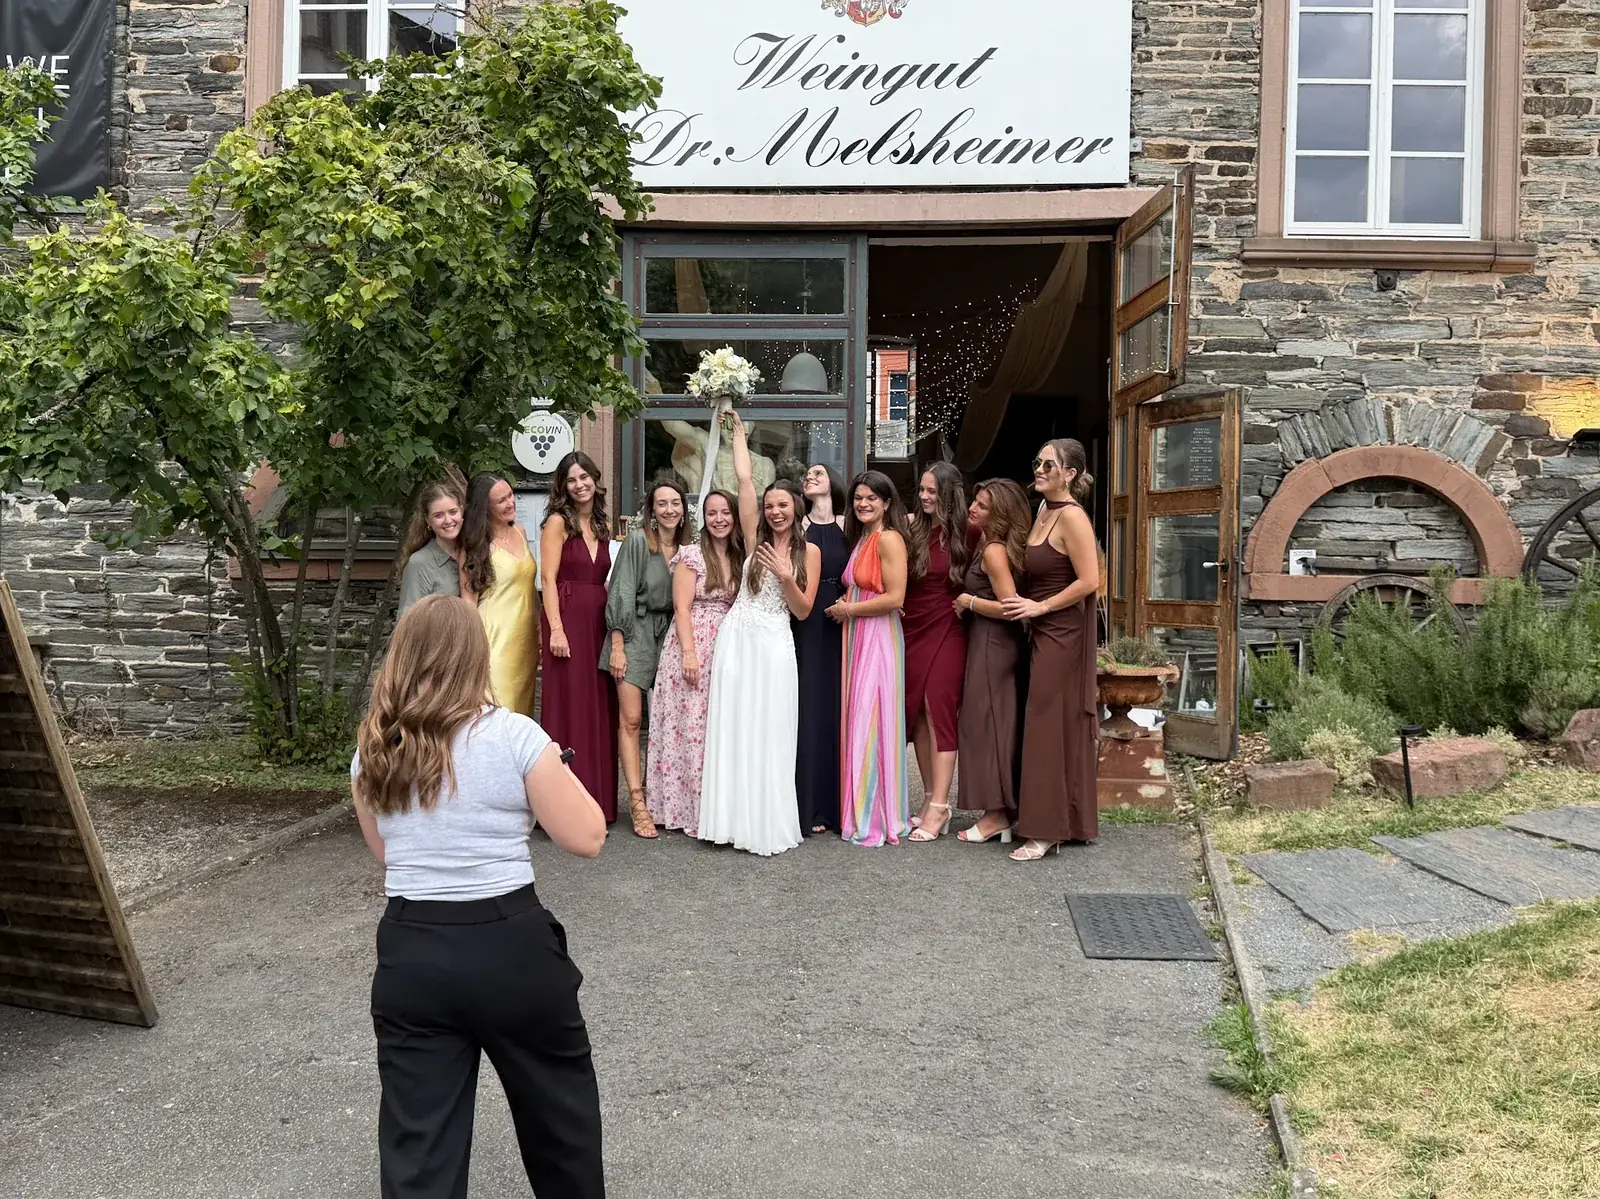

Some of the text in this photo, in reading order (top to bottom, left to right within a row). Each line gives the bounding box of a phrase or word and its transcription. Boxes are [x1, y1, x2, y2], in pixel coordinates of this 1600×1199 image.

[733, 32, 999, 106] Weingut
[629, 105, 1115, 167] Dr. Melsheimer
[523, 425, 562, 435] ECOVIN
